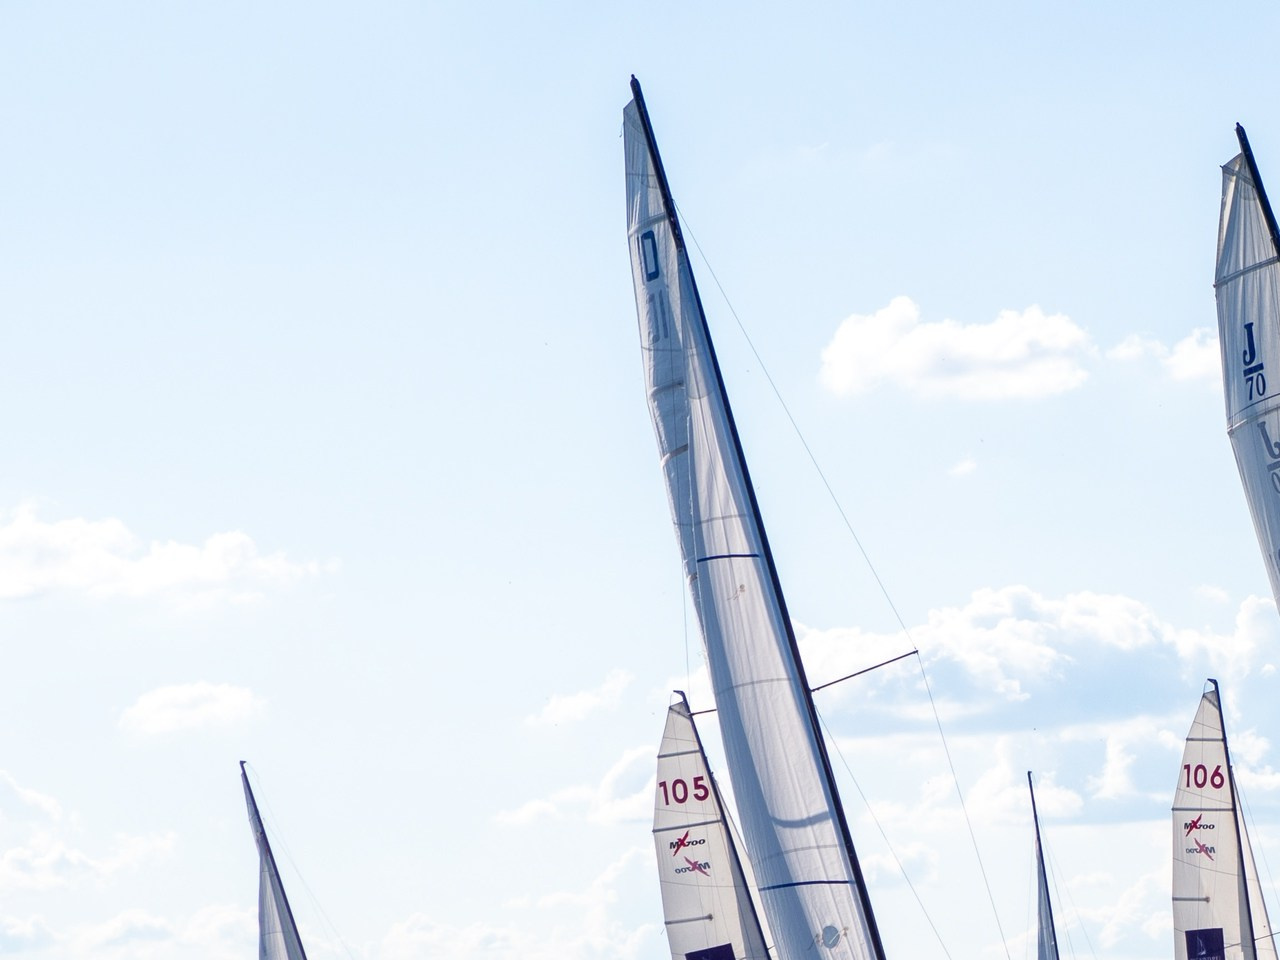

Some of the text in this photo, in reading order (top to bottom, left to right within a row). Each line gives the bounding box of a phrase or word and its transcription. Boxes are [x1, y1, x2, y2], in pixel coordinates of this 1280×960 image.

[1245, 372, 1267, 401] 70
[658, 775, 710, 806] 105
[1183, 763, 1225, 790] 106
